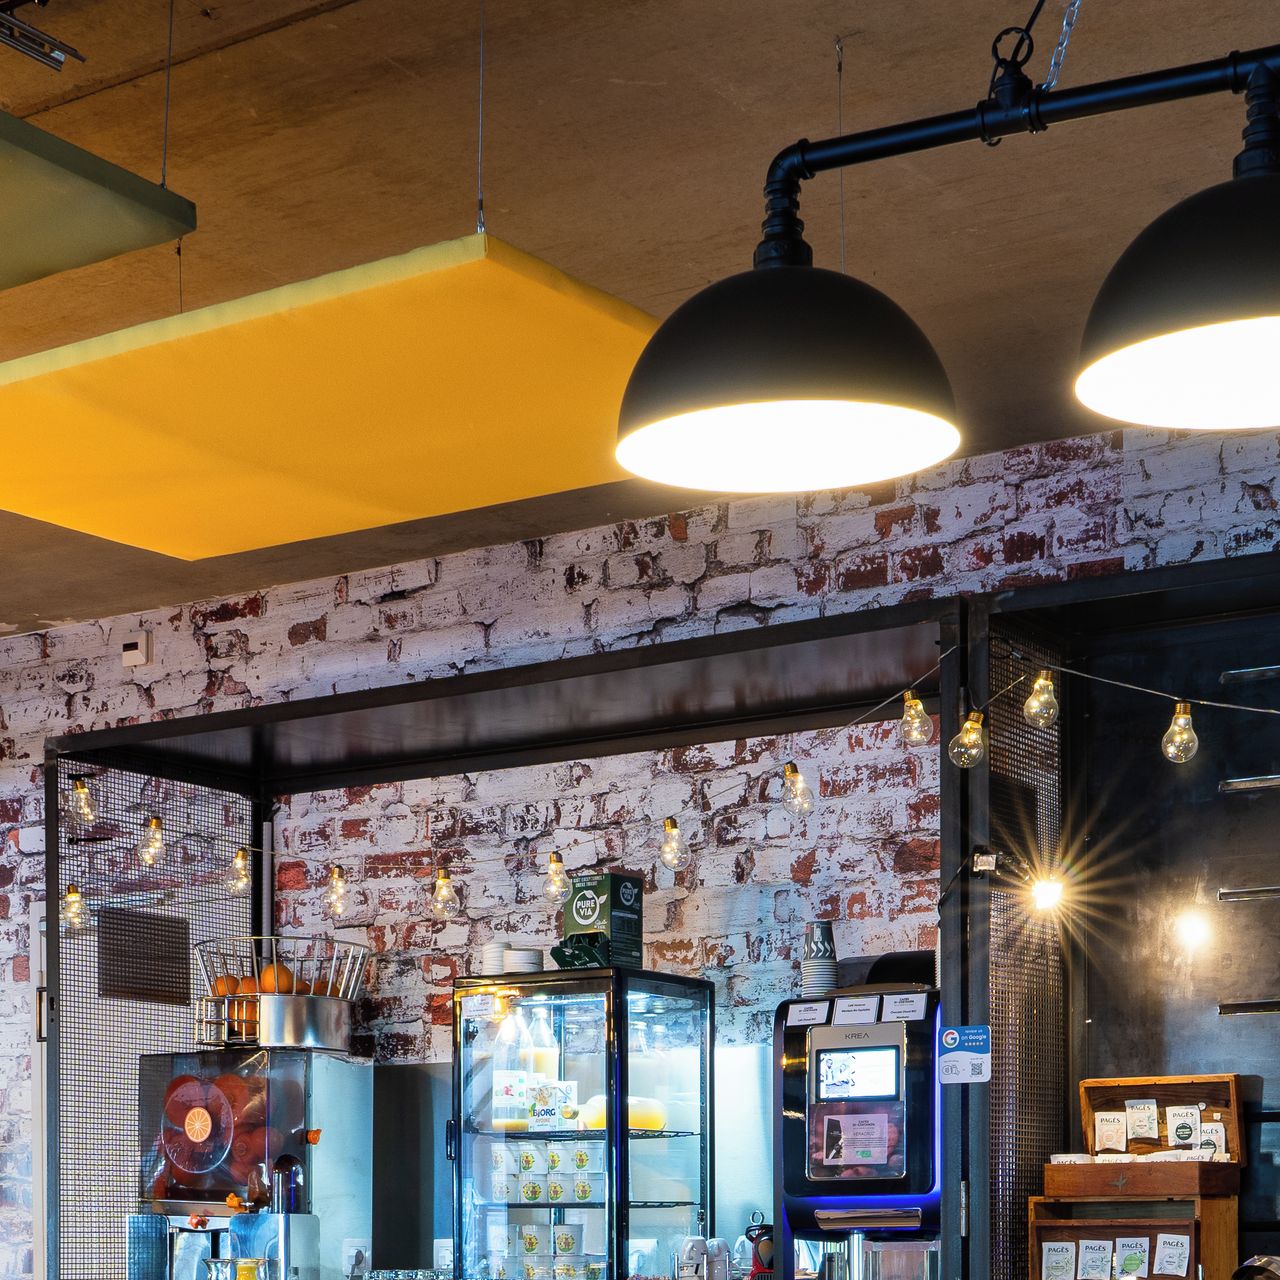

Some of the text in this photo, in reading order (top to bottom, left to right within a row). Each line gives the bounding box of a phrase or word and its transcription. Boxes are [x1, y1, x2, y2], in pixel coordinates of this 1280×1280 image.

[577, 900, 596, 909] PURE
[580, 908, 593, 916] VIA
[844, 1032, 870, 1040] KREA
